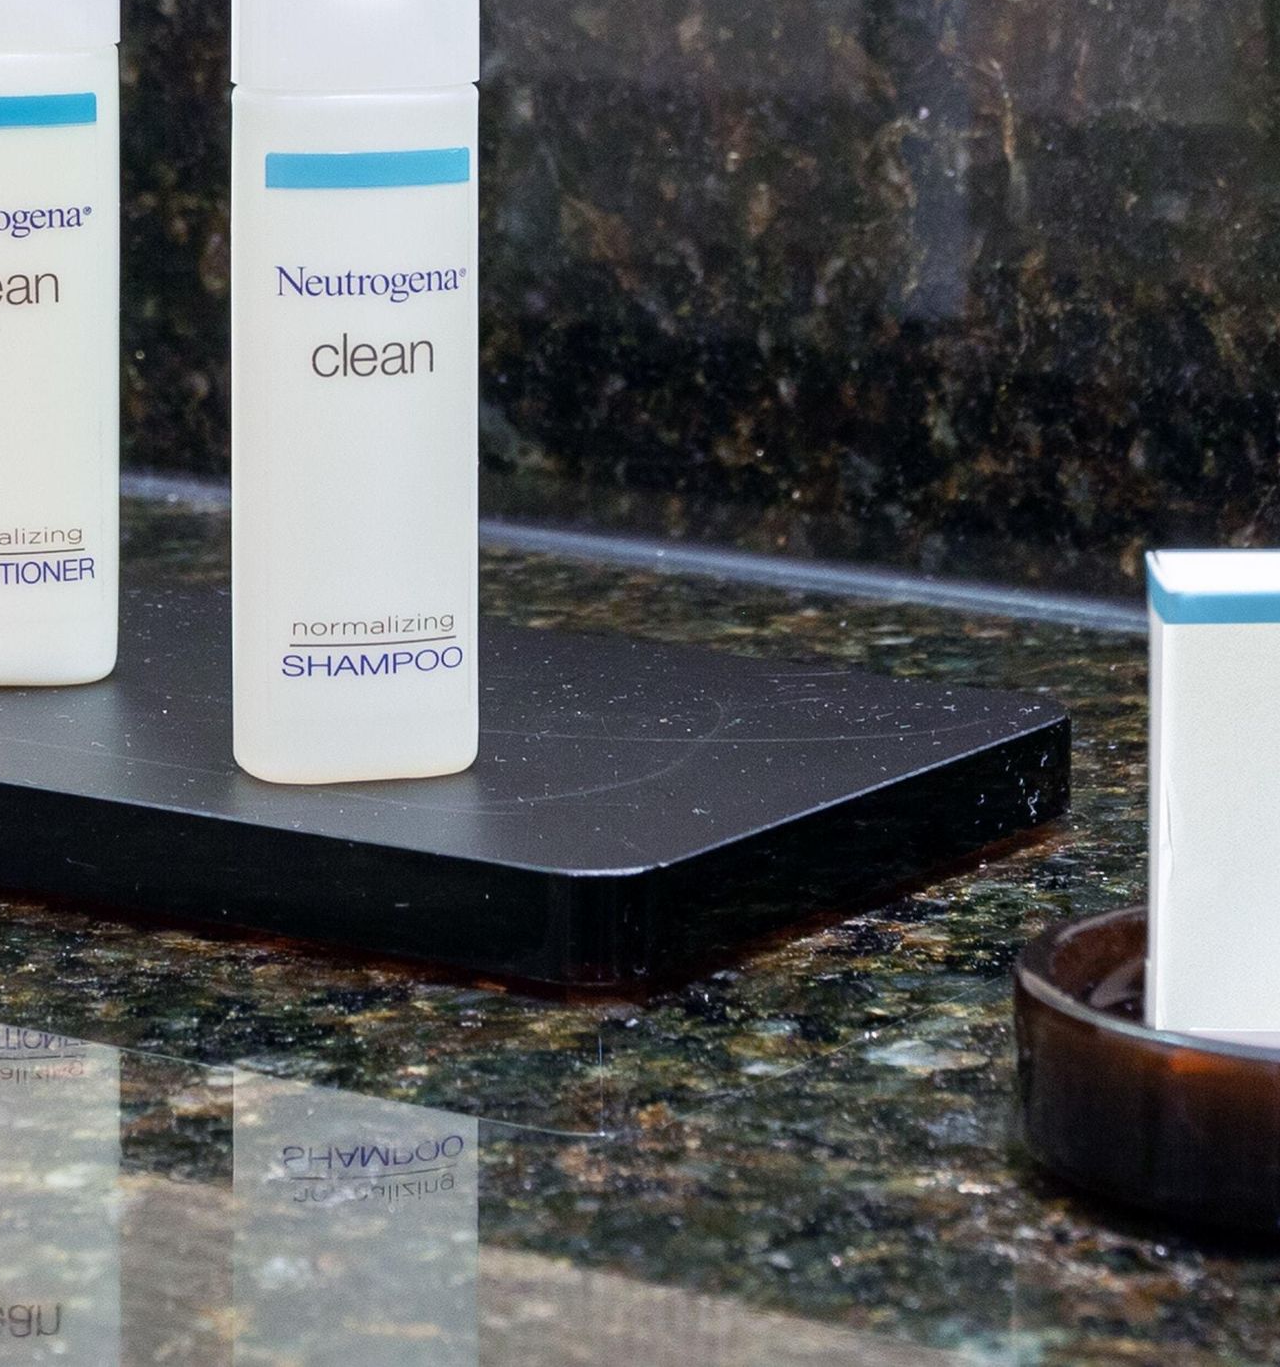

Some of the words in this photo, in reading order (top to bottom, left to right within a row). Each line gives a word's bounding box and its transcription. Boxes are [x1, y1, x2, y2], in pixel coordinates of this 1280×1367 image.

[312, 333, 434, 378] clean
[293, 613, 455, 634] normalizing
[282, 646, 463, 677] SHAMPOO
